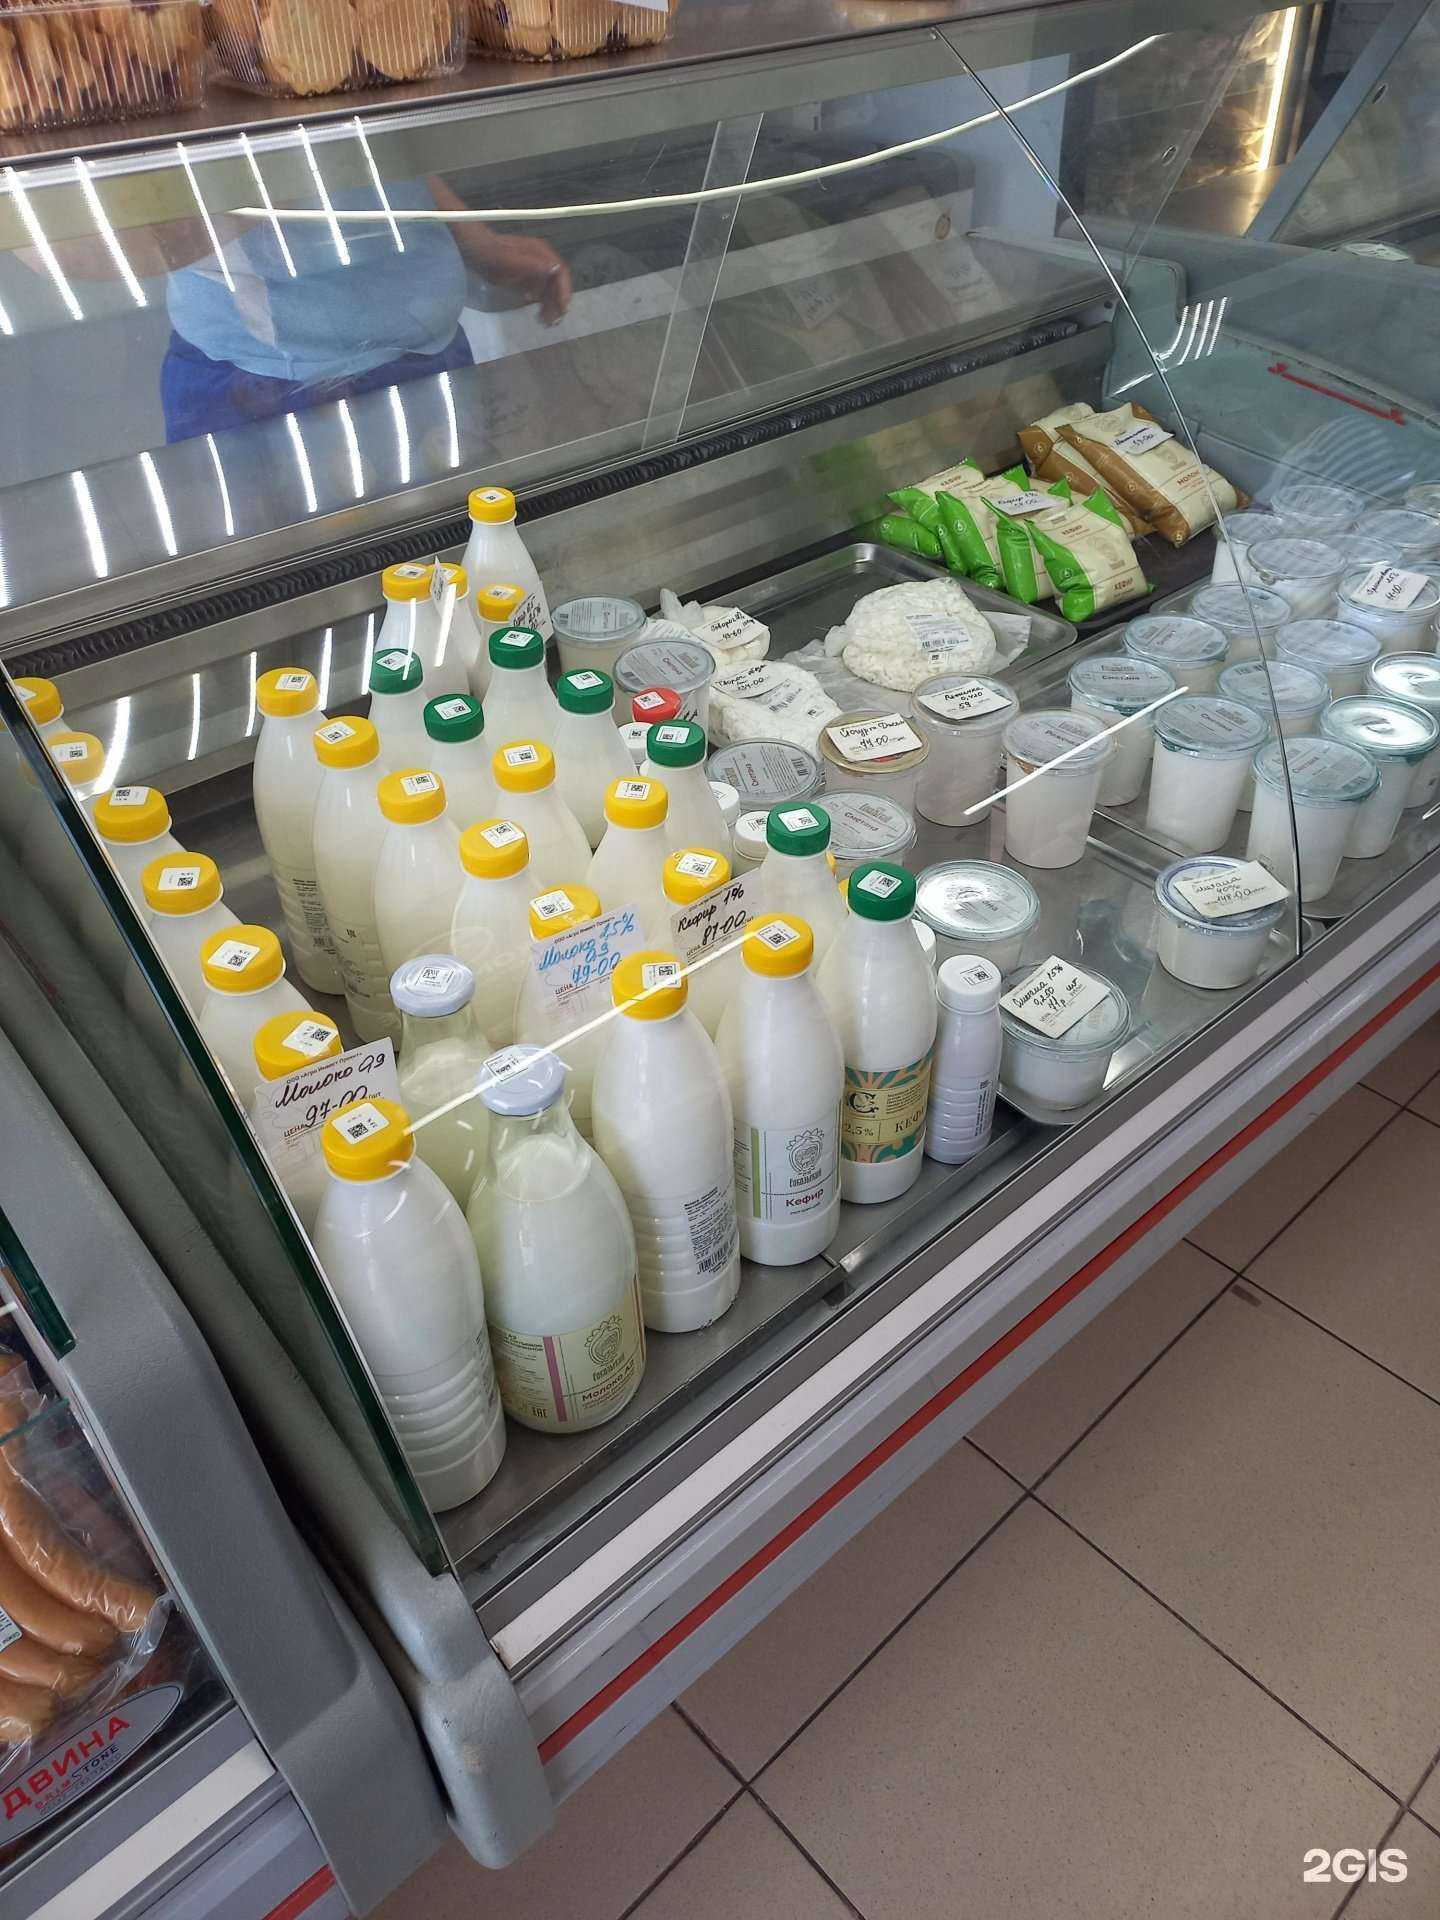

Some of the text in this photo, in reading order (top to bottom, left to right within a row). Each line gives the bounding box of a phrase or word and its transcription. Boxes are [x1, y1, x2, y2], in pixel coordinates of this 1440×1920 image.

[723, 883, 745, 905] 1%
[537, 938, 597, 972] Молоко
[275, 1065, 353, 1109] Молоко
[786, 1188, 824, 1207] Кефир
[582, 1374, 623, 1401] Молоко
[3, 1715, 131, 1821] ДВИНА
